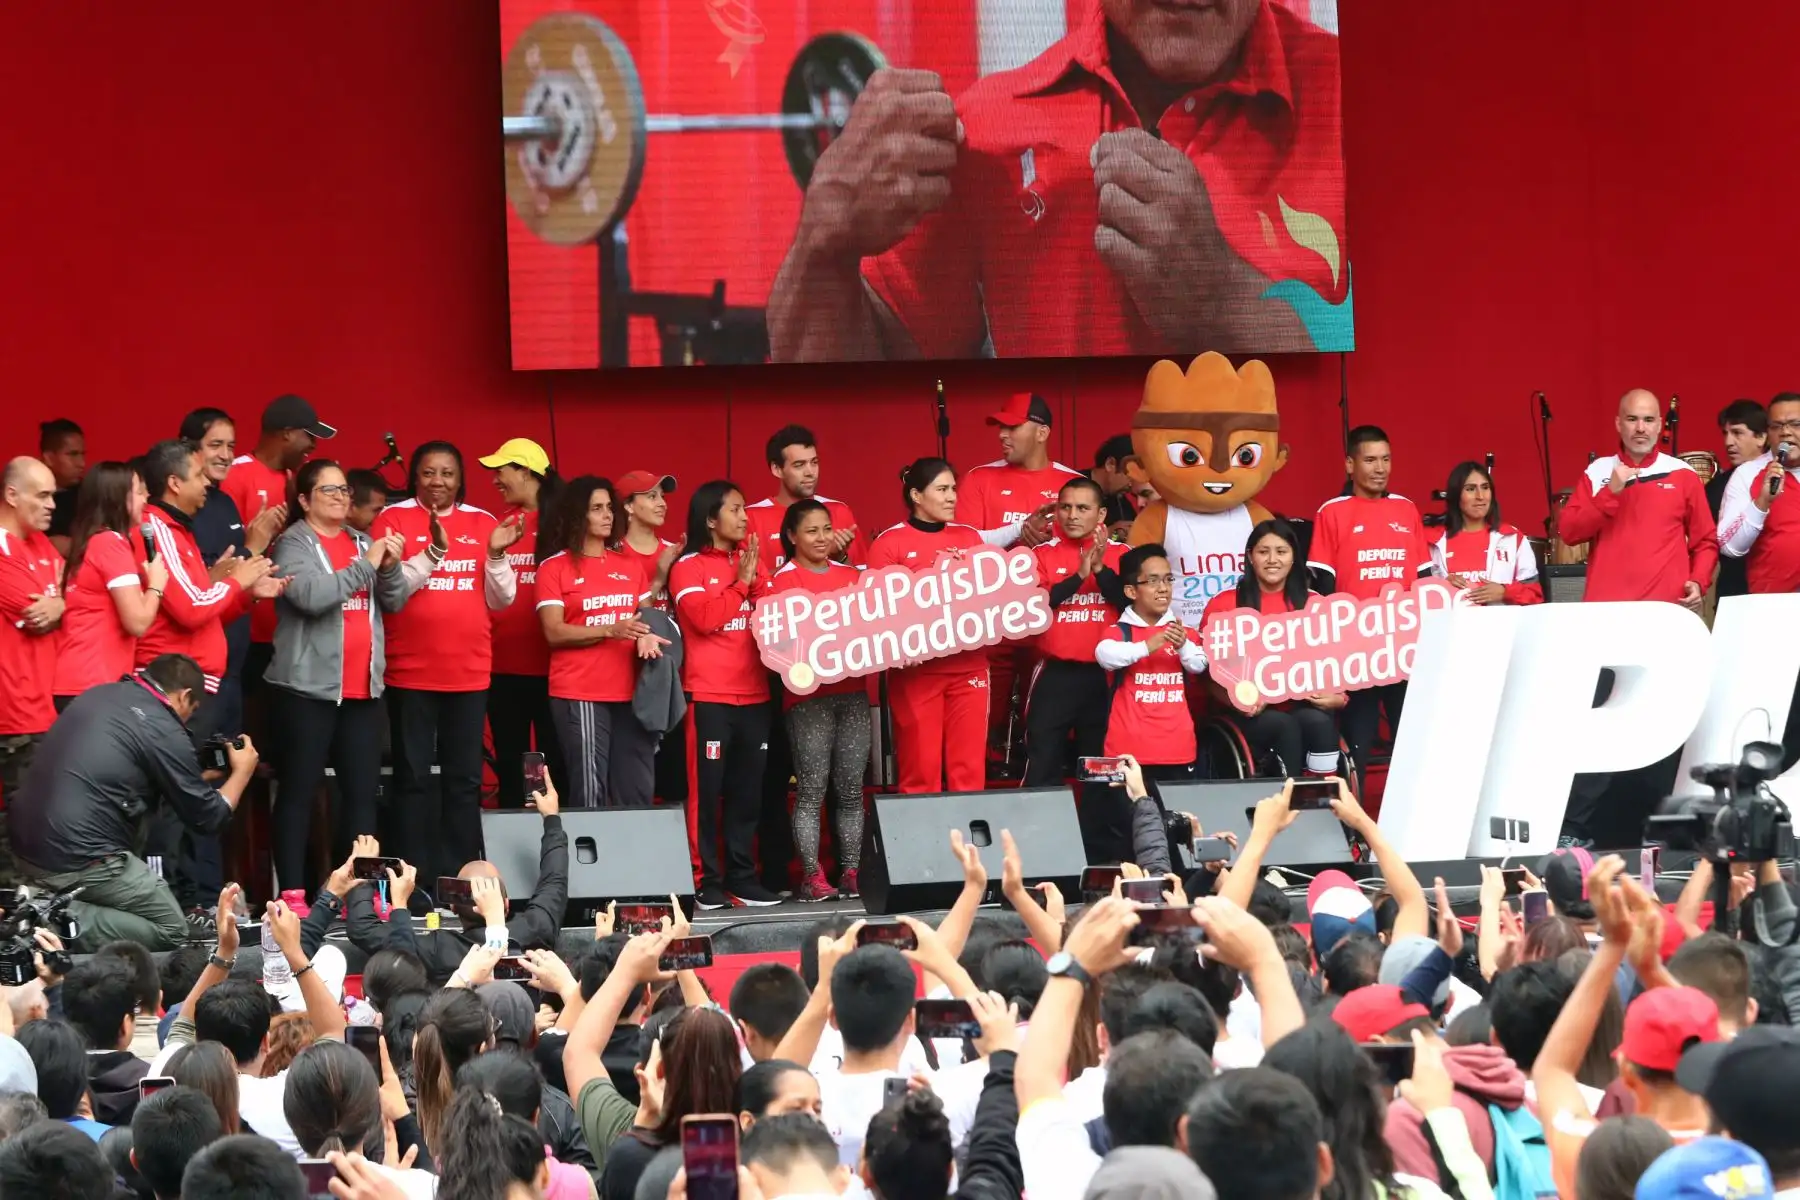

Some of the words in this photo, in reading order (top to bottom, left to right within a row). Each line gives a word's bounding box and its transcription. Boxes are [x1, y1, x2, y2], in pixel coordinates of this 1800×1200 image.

[1357, 548, 1406, 562] DEPORTE
[1360, 563, 1391, 580] PERÚ
[457, 577, 475, 591] 5K
[1183, 574, 1246, 599] 201
[582, 593, 634, 611] DEPORTE
[759, 550, 1034, 646] #PerúPaísDe
[585, 610, 616, 627] PERÚ
[1057, 608, 1090, 623] PERÚ
[1091, 610, 1106, 623] 5K
[808, 595, 1048, 677] Ganadores
[1253, 632, 1418, 698] Ganado
[1134, 671, 1184, 686] DEPORTE
[1134, 687, 1166, 704] PERÚ
[1167, 689, 1184, 703] 5K
